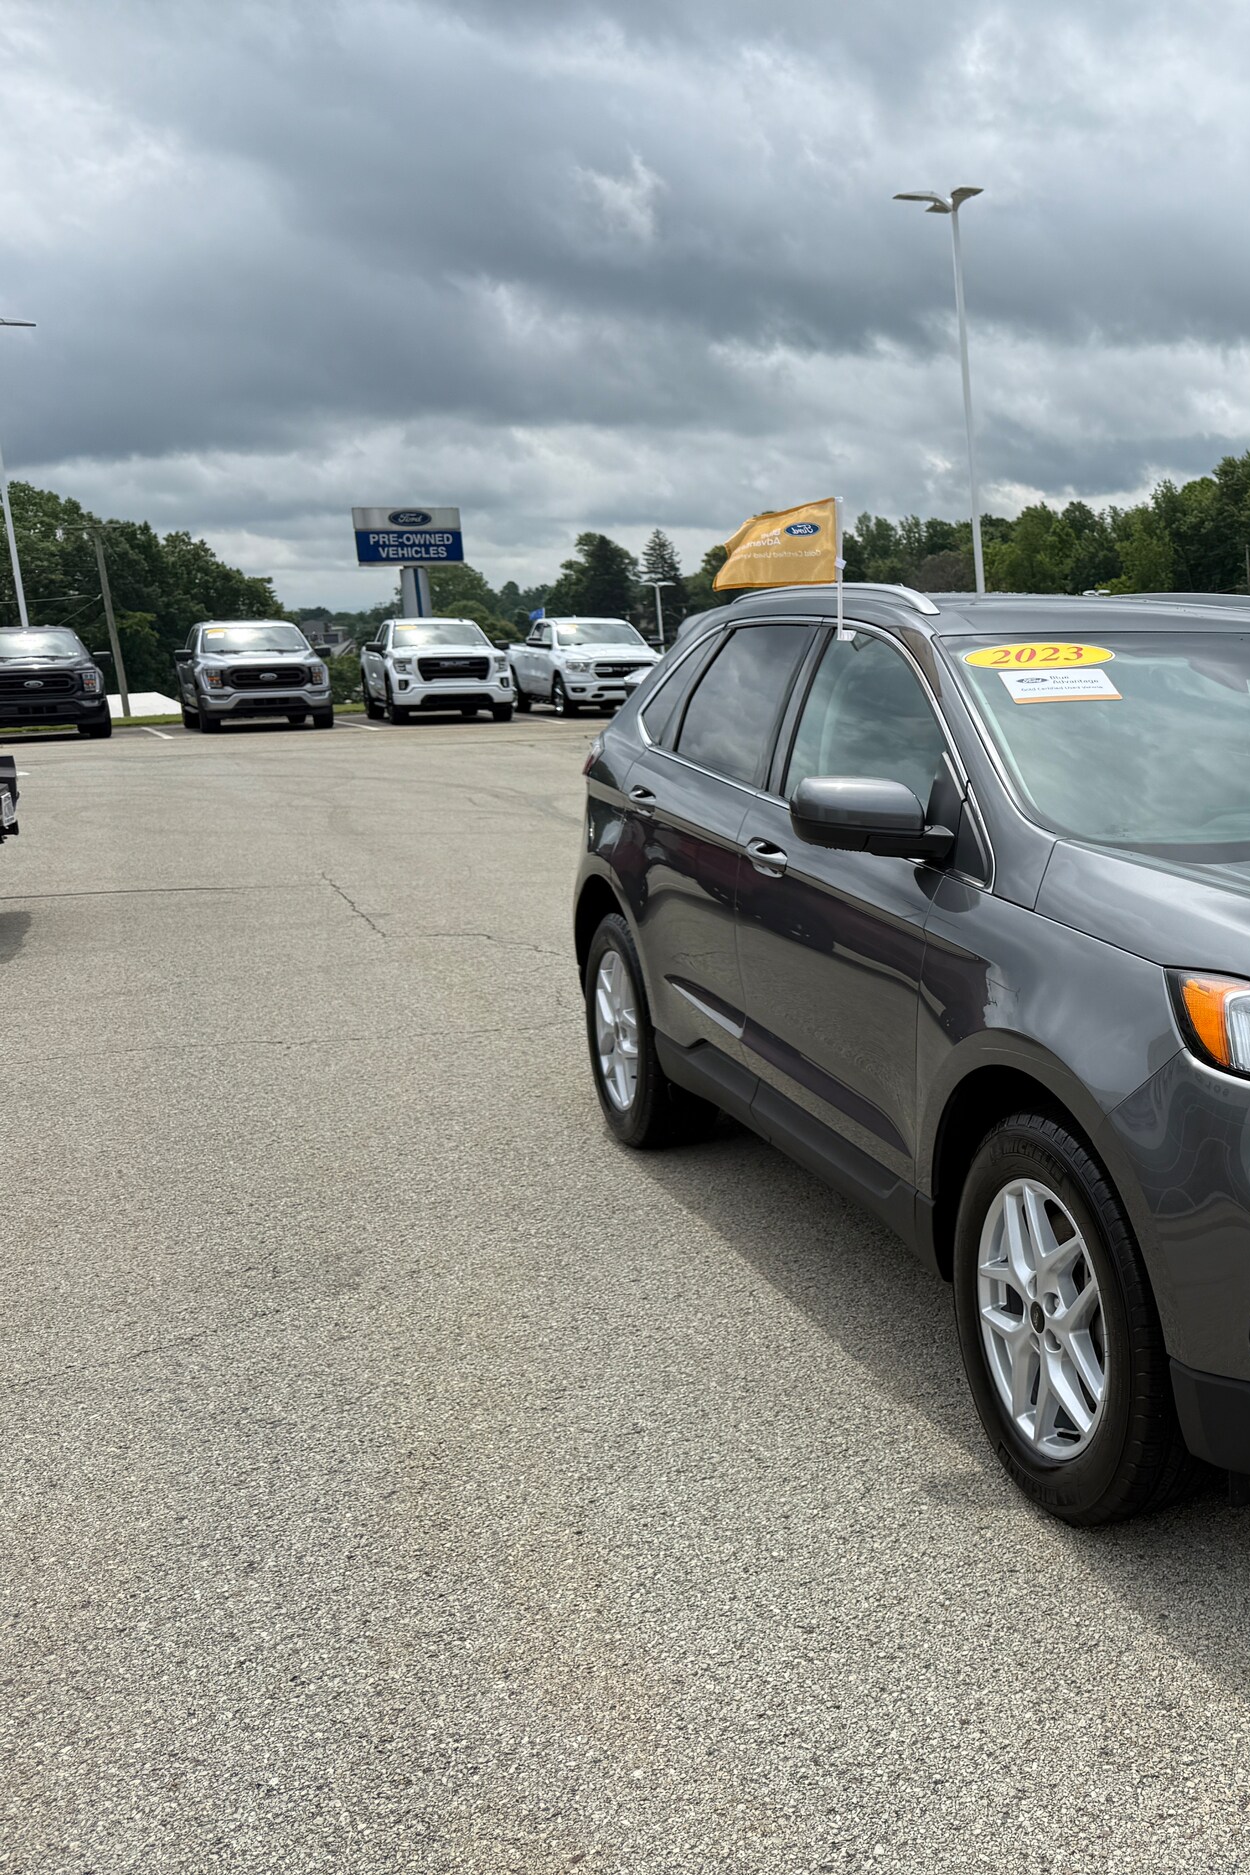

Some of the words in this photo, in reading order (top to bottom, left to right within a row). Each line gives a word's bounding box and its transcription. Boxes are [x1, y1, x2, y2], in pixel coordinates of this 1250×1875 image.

[398, 512, 422, 523] Ford
[369, 533, 453, 546] PRE-OWNED
[378, 546, 448, 558] VEHICLES
[990, 646, 1084, 665] 2023
